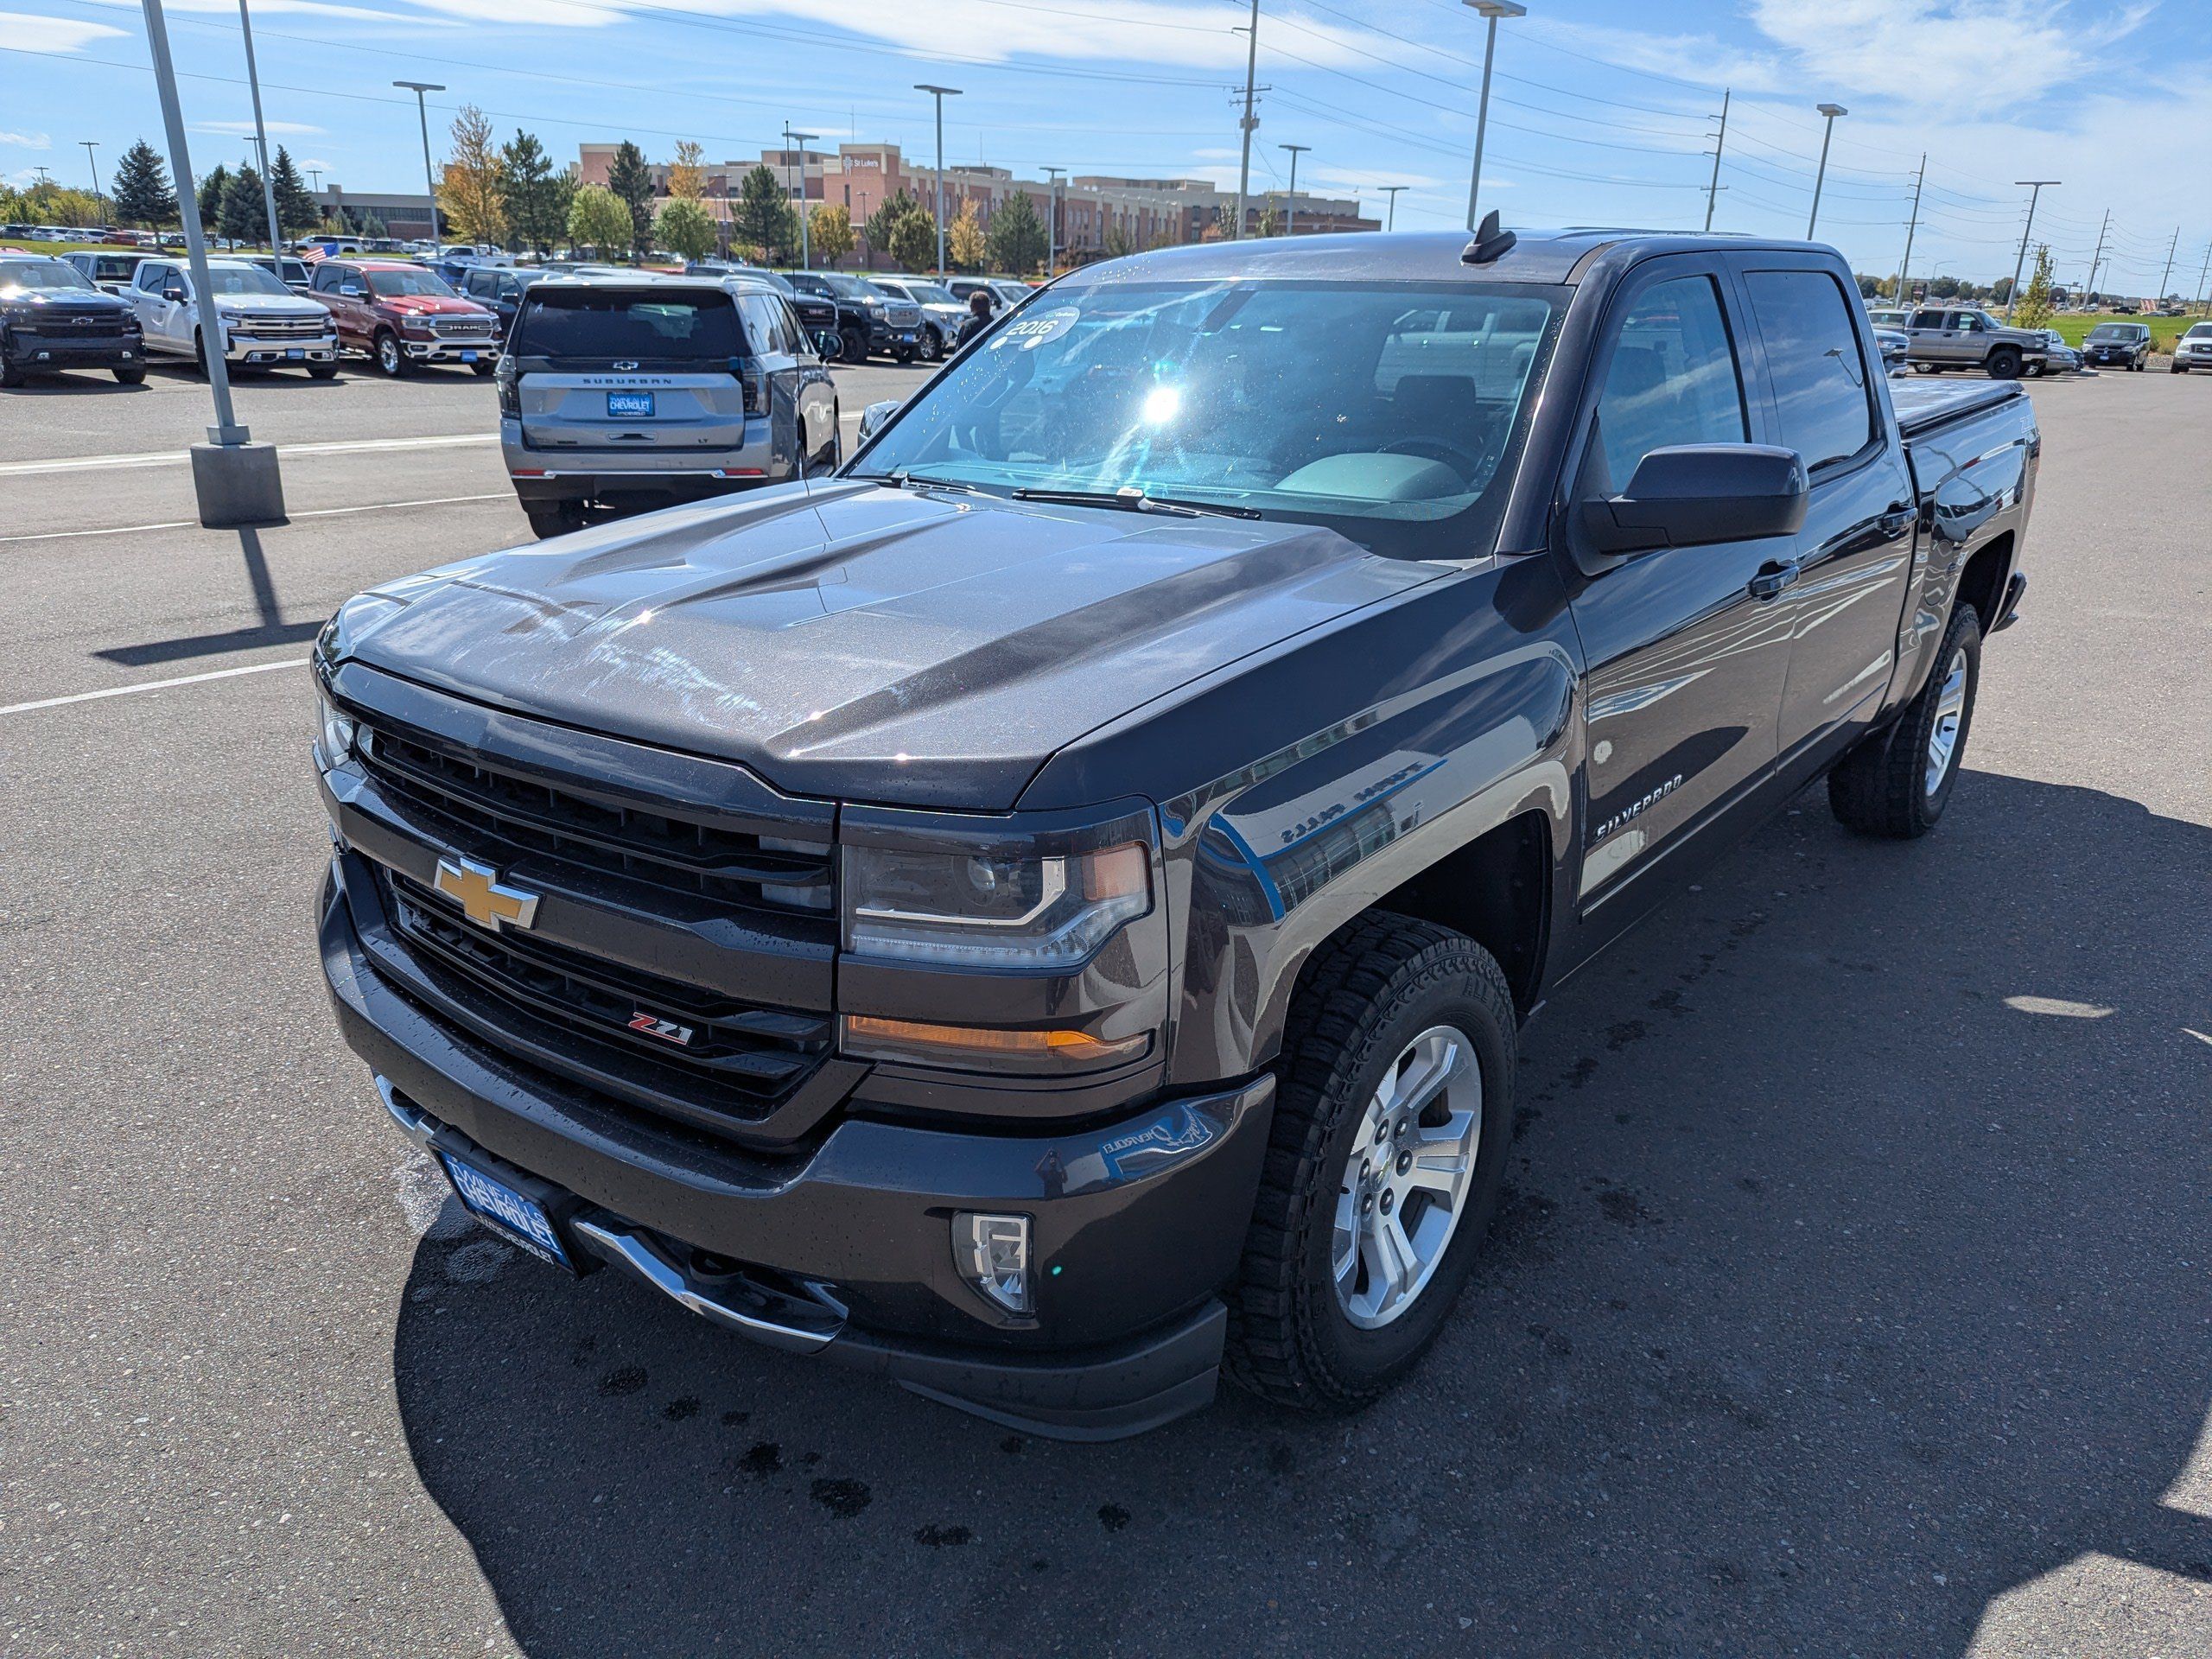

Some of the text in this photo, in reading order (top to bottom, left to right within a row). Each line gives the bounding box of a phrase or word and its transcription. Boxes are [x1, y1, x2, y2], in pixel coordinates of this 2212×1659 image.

[1006, 320, 1058, 336] 2016
[1593, 773, 1683, 842] SILVERADO
[628, 1012, 693, 1046] Z71
[454, 1174, 560, 1249] CHEVROLET
